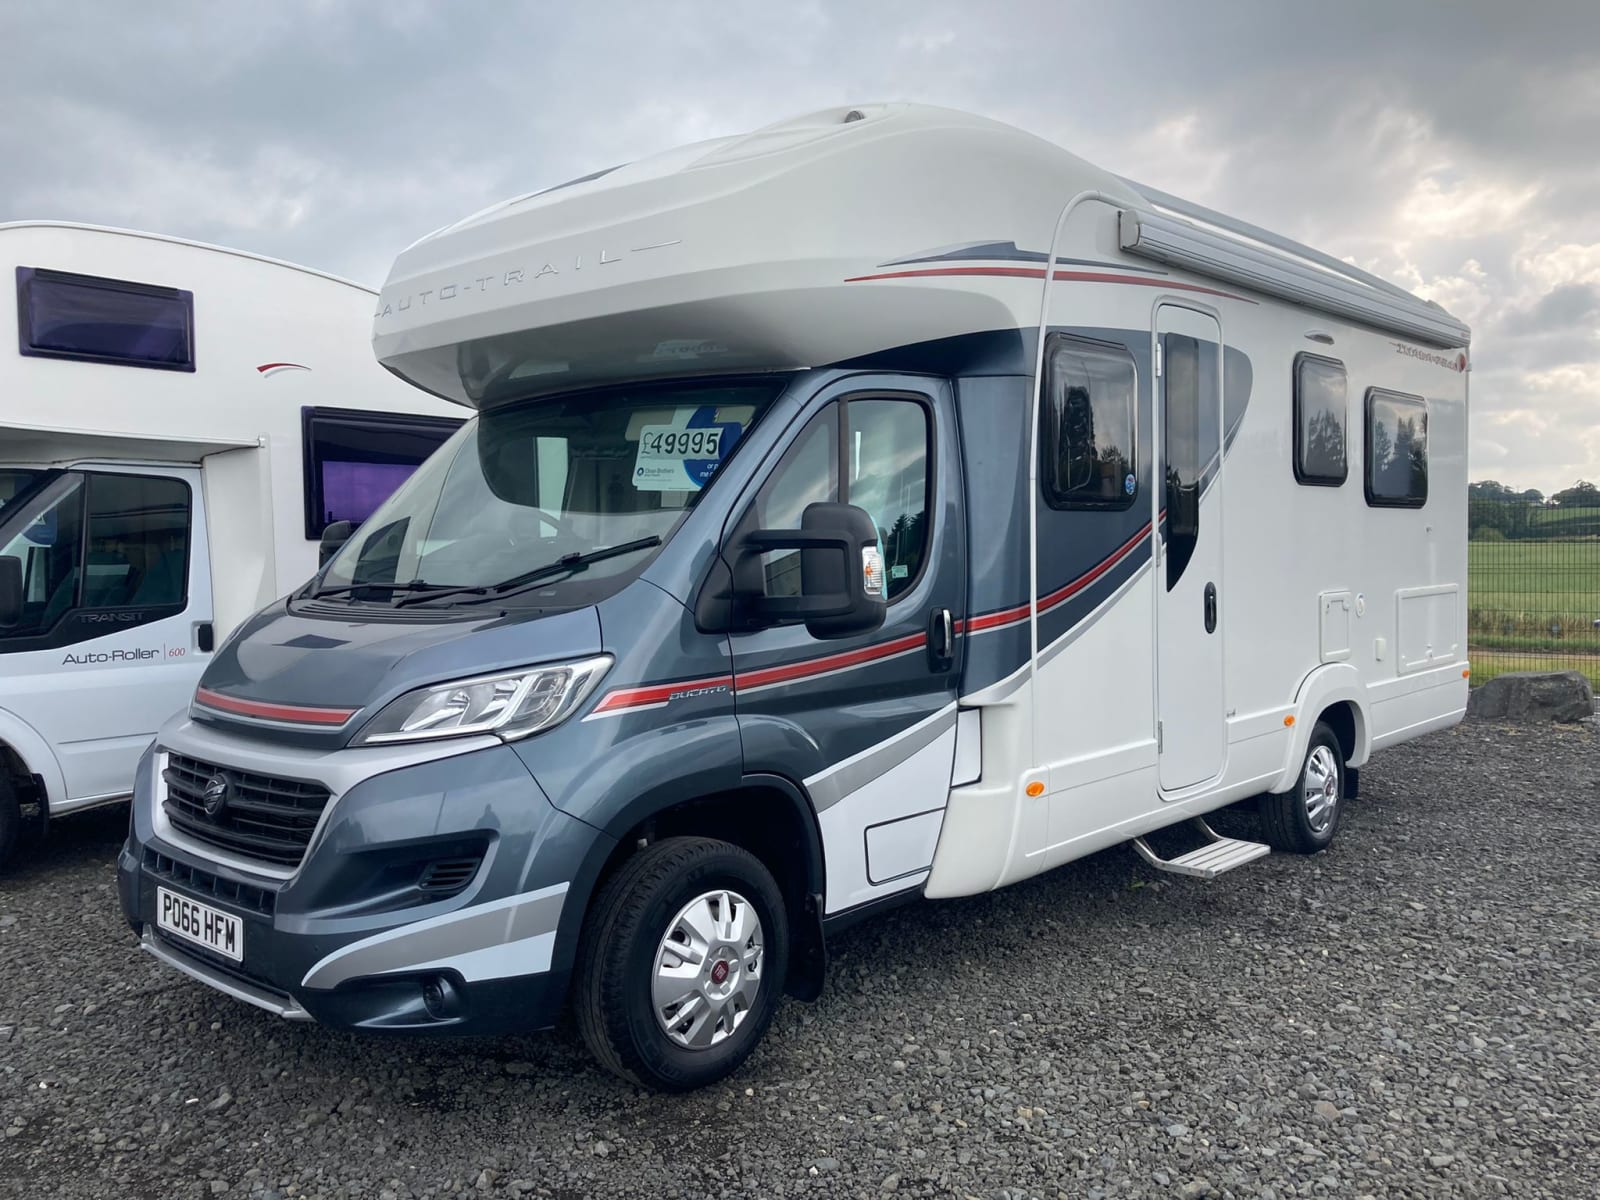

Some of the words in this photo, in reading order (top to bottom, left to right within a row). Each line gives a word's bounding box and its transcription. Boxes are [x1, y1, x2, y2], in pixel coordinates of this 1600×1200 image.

[380, 249, 622, 318] AUTO-TRAIL
[642, 431, 718, 454] £49995
[80, 613, 143, 623] TRANSIT
[62, 648, 160, 665] Auto-Roller
[168, 647, 186, 657] 600
[163, 893, 200, 936] PO66
[204, 910, 235, 953] HFM
